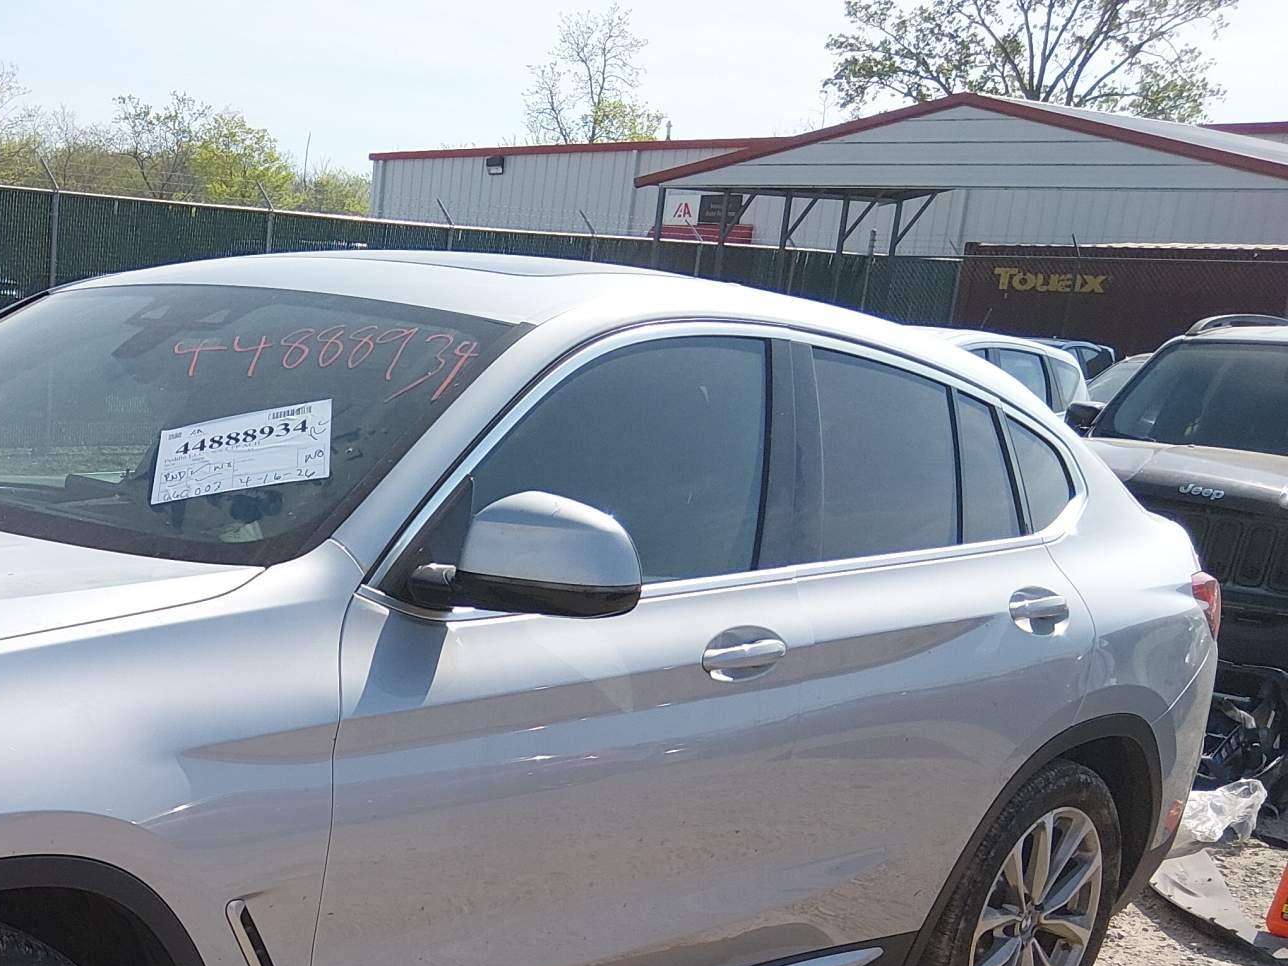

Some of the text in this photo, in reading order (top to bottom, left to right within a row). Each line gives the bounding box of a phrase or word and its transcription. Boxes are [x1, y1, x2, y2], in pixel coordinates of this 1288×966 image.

[174, 324, 480, 402] 44888934
[175, 419, 309, 455] 44888934
[1178, 483, 1225, 500] Jeep
